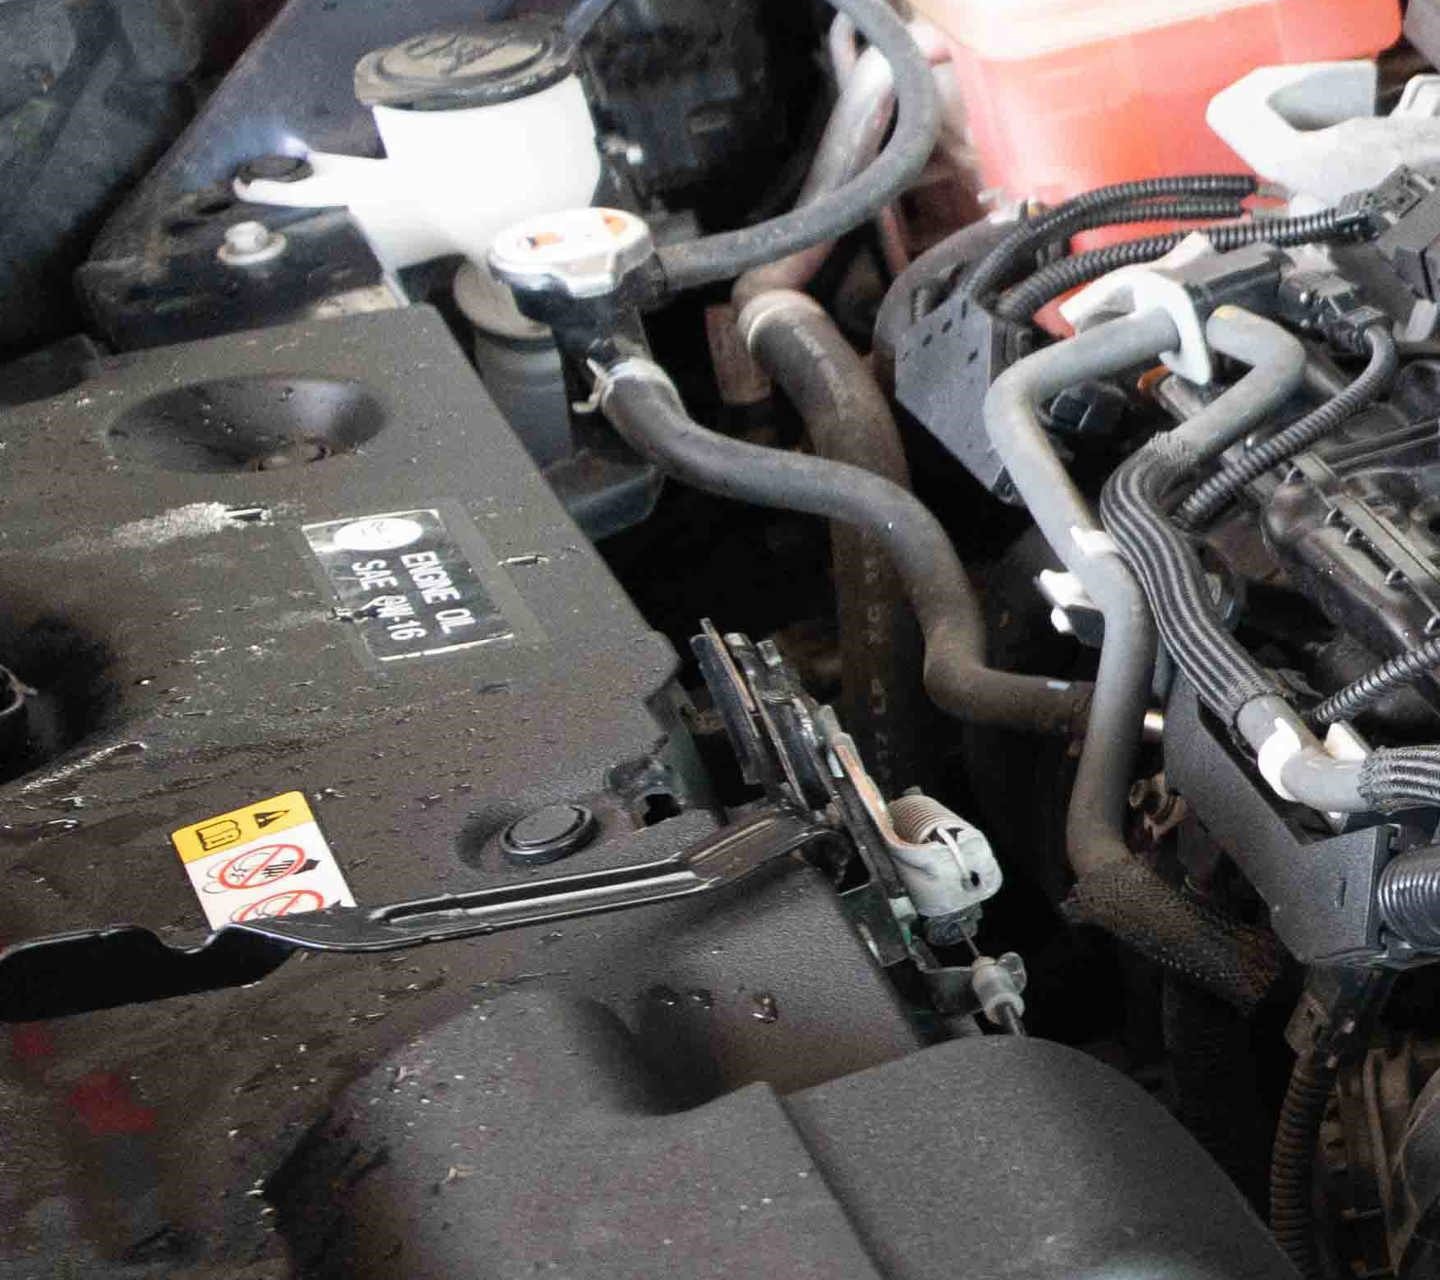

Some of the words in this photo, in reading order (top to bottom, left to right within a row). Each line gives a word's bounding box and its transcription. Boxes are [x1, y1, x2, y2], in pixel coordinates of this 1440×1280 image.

[351, 559, 399, 591] SAE
[376, 594, 427, 641] 0W-16
[400, 550, 461, 604] ENGINE
[434, 608, 476, 635] OIL
